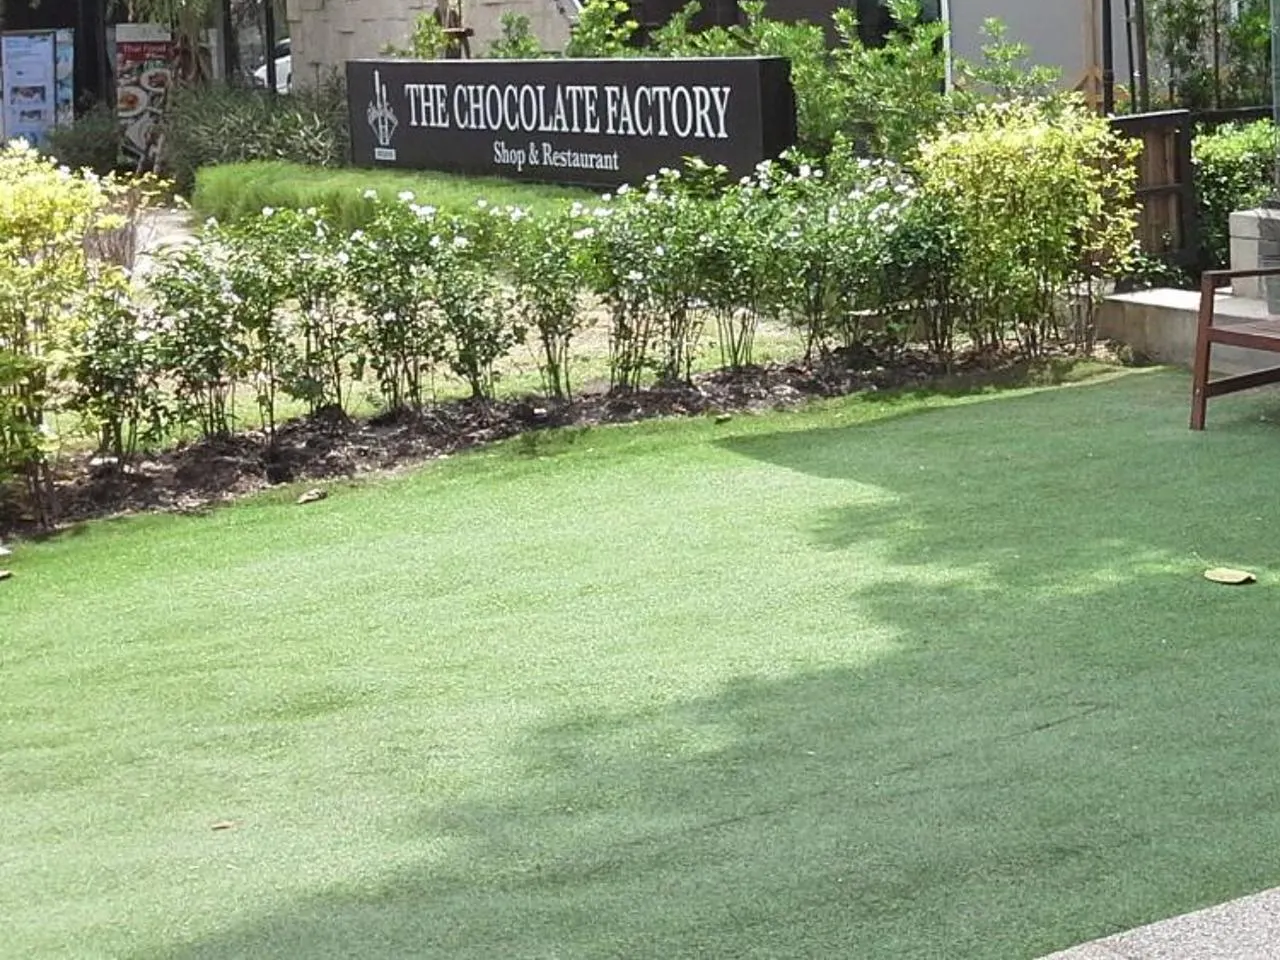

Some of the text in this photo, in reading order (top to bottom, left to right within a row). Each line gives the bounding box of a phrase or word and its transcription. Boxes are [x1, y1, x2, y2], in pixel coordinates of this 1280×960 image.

[404, 83, 731, 138] THE CHOCOLATE FACTORY
[494, 141, 619, 172] Shop & Restaurant
